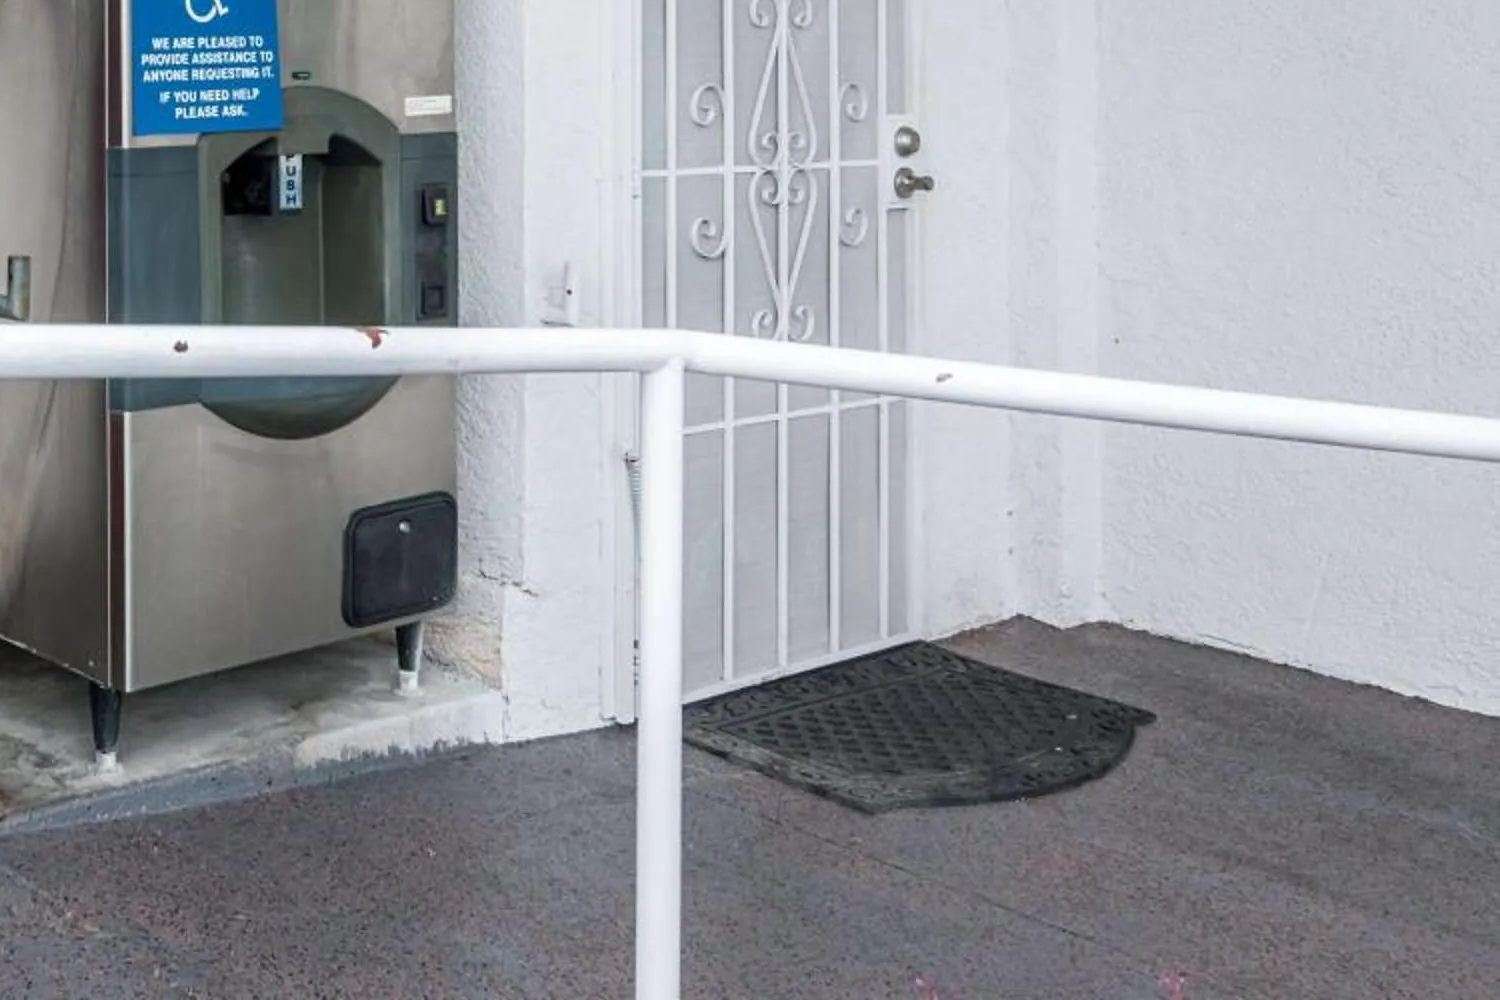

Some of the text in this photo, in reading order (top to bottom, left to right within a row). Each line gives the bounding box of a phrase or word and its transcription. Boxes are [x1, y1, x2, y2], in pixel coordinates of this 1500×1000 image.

[152, 35, 263, 49] WE ARE PLEASED TO
[141, 51, 273, 65] PROVIDE ASSISTANCE TO
[143, 66, 274, 82] ANYONE REQUESTING IT.
[159, 88, 260, 103] IF YOU NEED HELP
[175, 105, 248, 119] PLEASE ASK.
